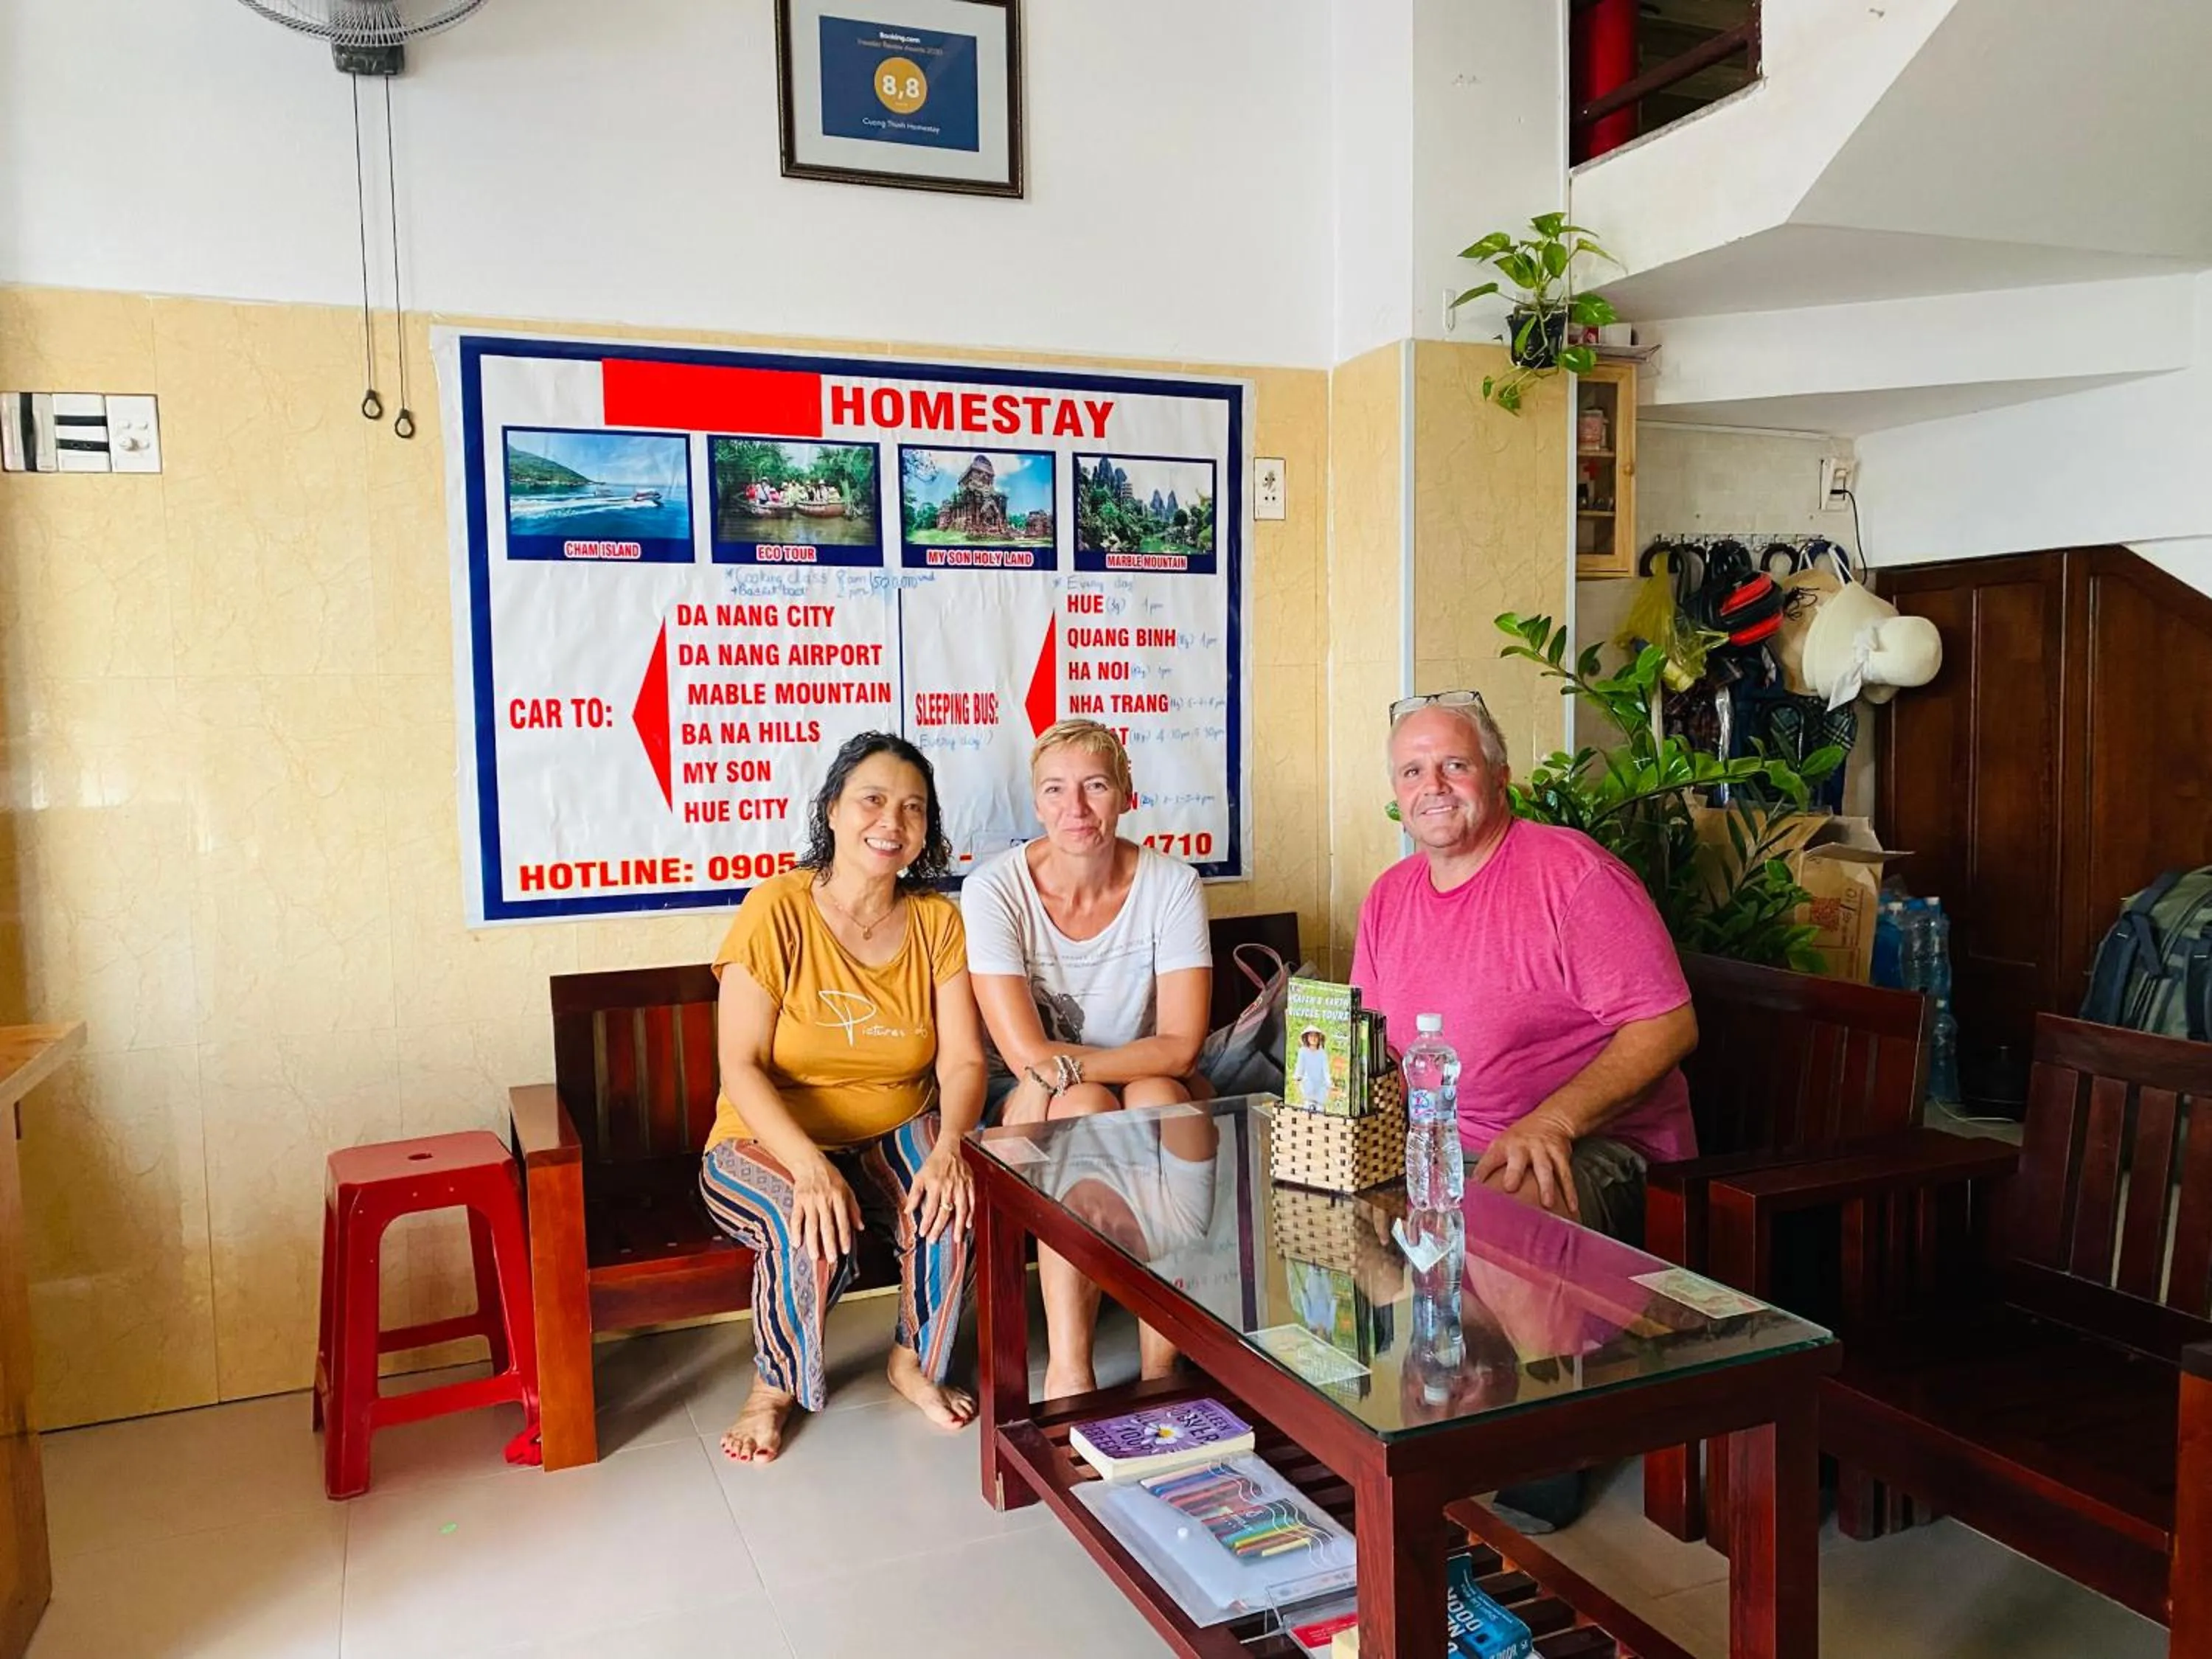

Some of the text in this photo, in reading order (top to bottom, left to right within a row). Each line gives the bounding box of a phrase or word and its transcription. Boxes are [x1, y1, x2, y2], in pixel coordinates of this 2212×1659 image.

[879, 32, 920, 44] Booking.com
[883, 75, 920, 100] 8,8
[906, 123, 940, 135] Homestay
[829, 383, 1116, 440] HOMESTAY
[566, 543, 639, 558] CHAM ISLAND
[757, 546, 815, 561] ECO TOUR
[928, 551, 1033, 566] MY SON HOLY LAND
[1107, 554, 1186, 569] MARBLE MOUNTAIN
[675, 602, 835, 629] DA NANG CITY
[1066, 593, 1104, 615] HUE
[1065, 626, 1177, 651] QUANG BINH
[677, 642, 883, 668] DA NANG AIRPORT
[1067, 660, 1130, 681] HA NOI
[687, 682, 891, 706] MABLE MOUNTAIN
[1068, 693, 1105, 714] NHA
[1110, 692, 1169, 714] TRANG
[508, 695, 613, 731] CAR TO:
[916, 692, 999, 726] SLEEPING BUS:
[680, 719, 821, 747] BA NA HILLS
[682, 759, 773, 785] MY SON
[684, 796, 790, 824] HUE CITY
[518, 832, 1212, 893] HOTLINE: 0905 4710
[1116, 1427, 1153, 1454] YOUR
